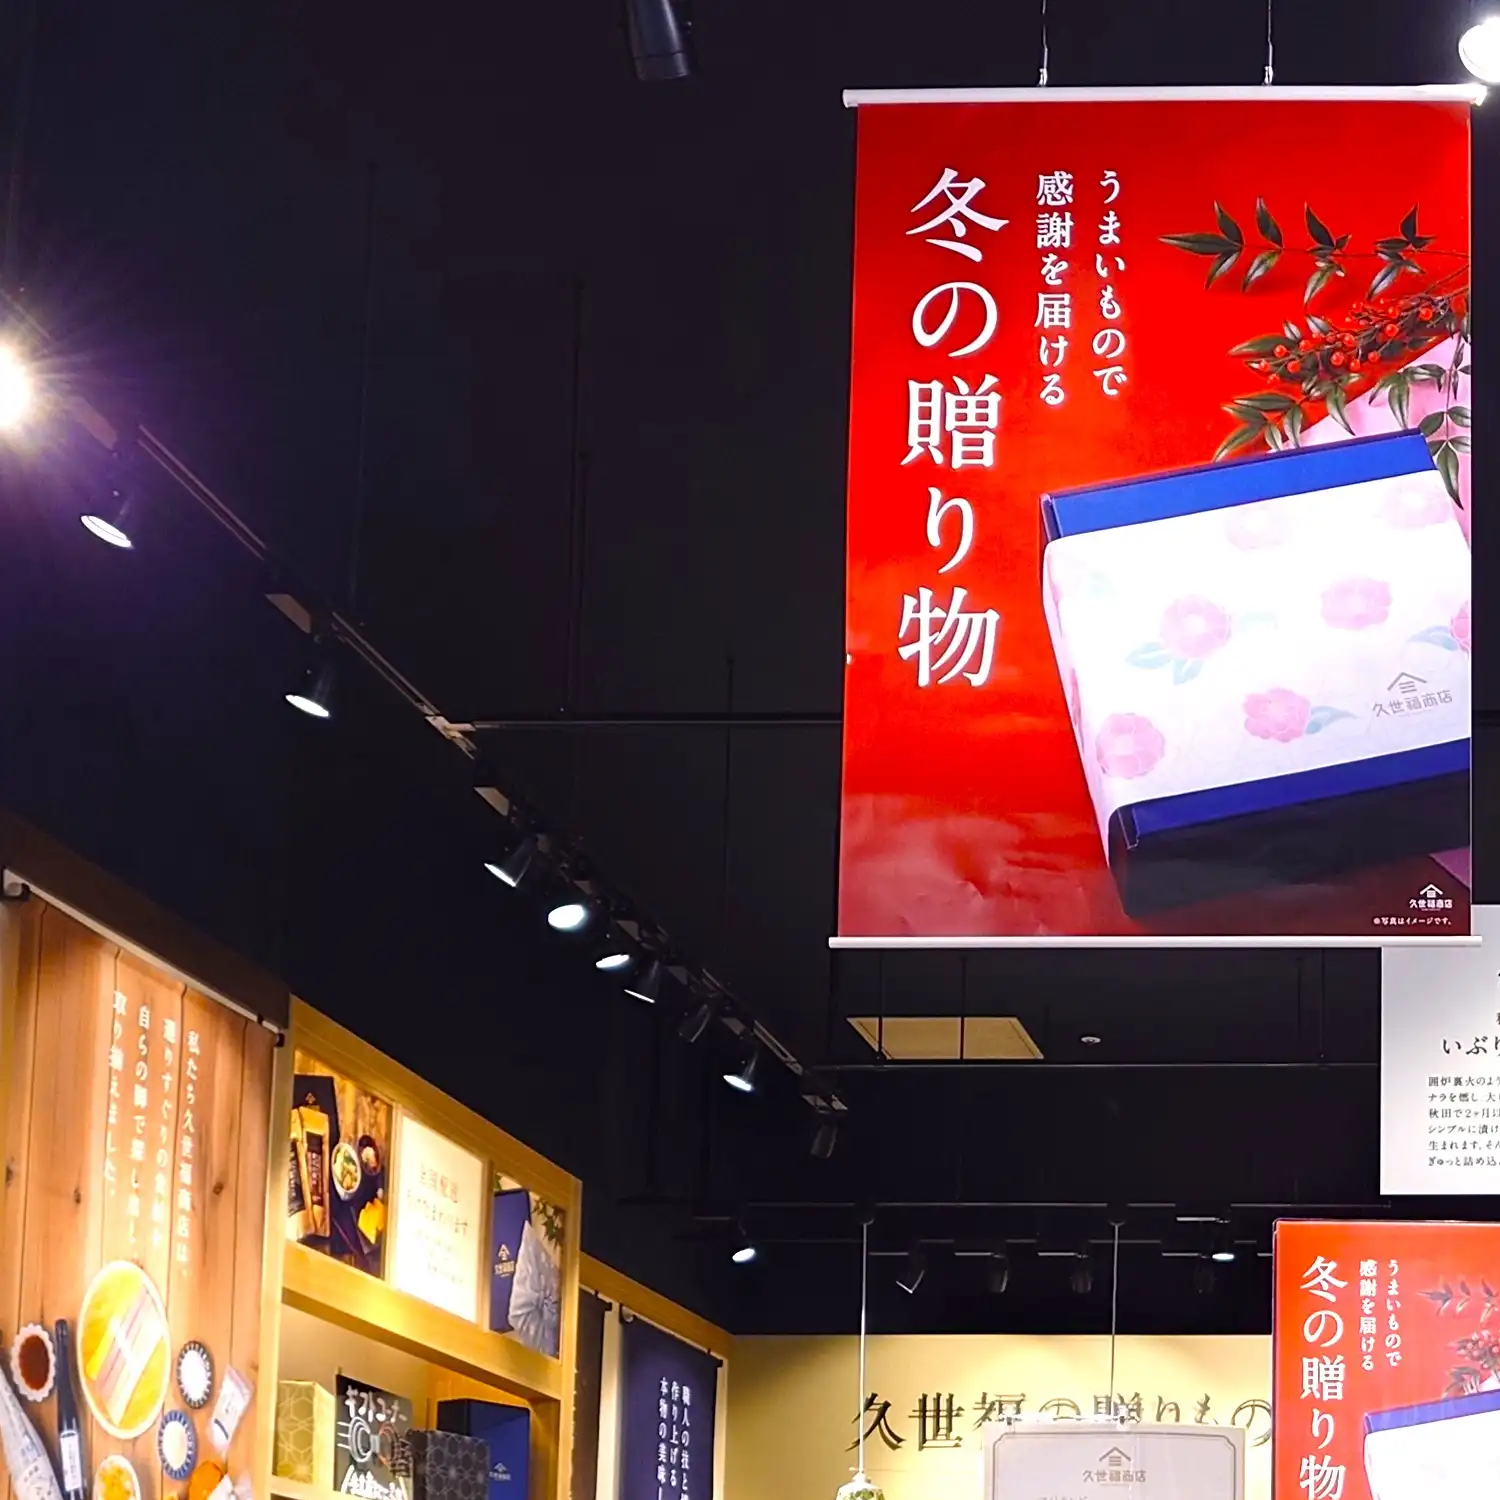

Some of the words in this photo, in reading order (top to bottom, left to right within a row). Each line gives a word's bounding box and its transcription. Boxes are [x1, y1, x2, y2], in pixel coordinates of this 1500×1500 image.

[1033, 170, 1075, 406] 感謝を届ける
[1090, 169, 1128, 397] うまいもので
[898, 166, 1010, 688] 冬の贈り物
[1372, 689, 1454, 718] 久世福商店
[1408, 898, 1454, 910] 久世福商店
[1360, 1259, 1379, 1371] 感謝を届ける
[1384, 1259, 1403, 1367] うまいもので
[669, 1380, 680, 1488] 作り上げる
